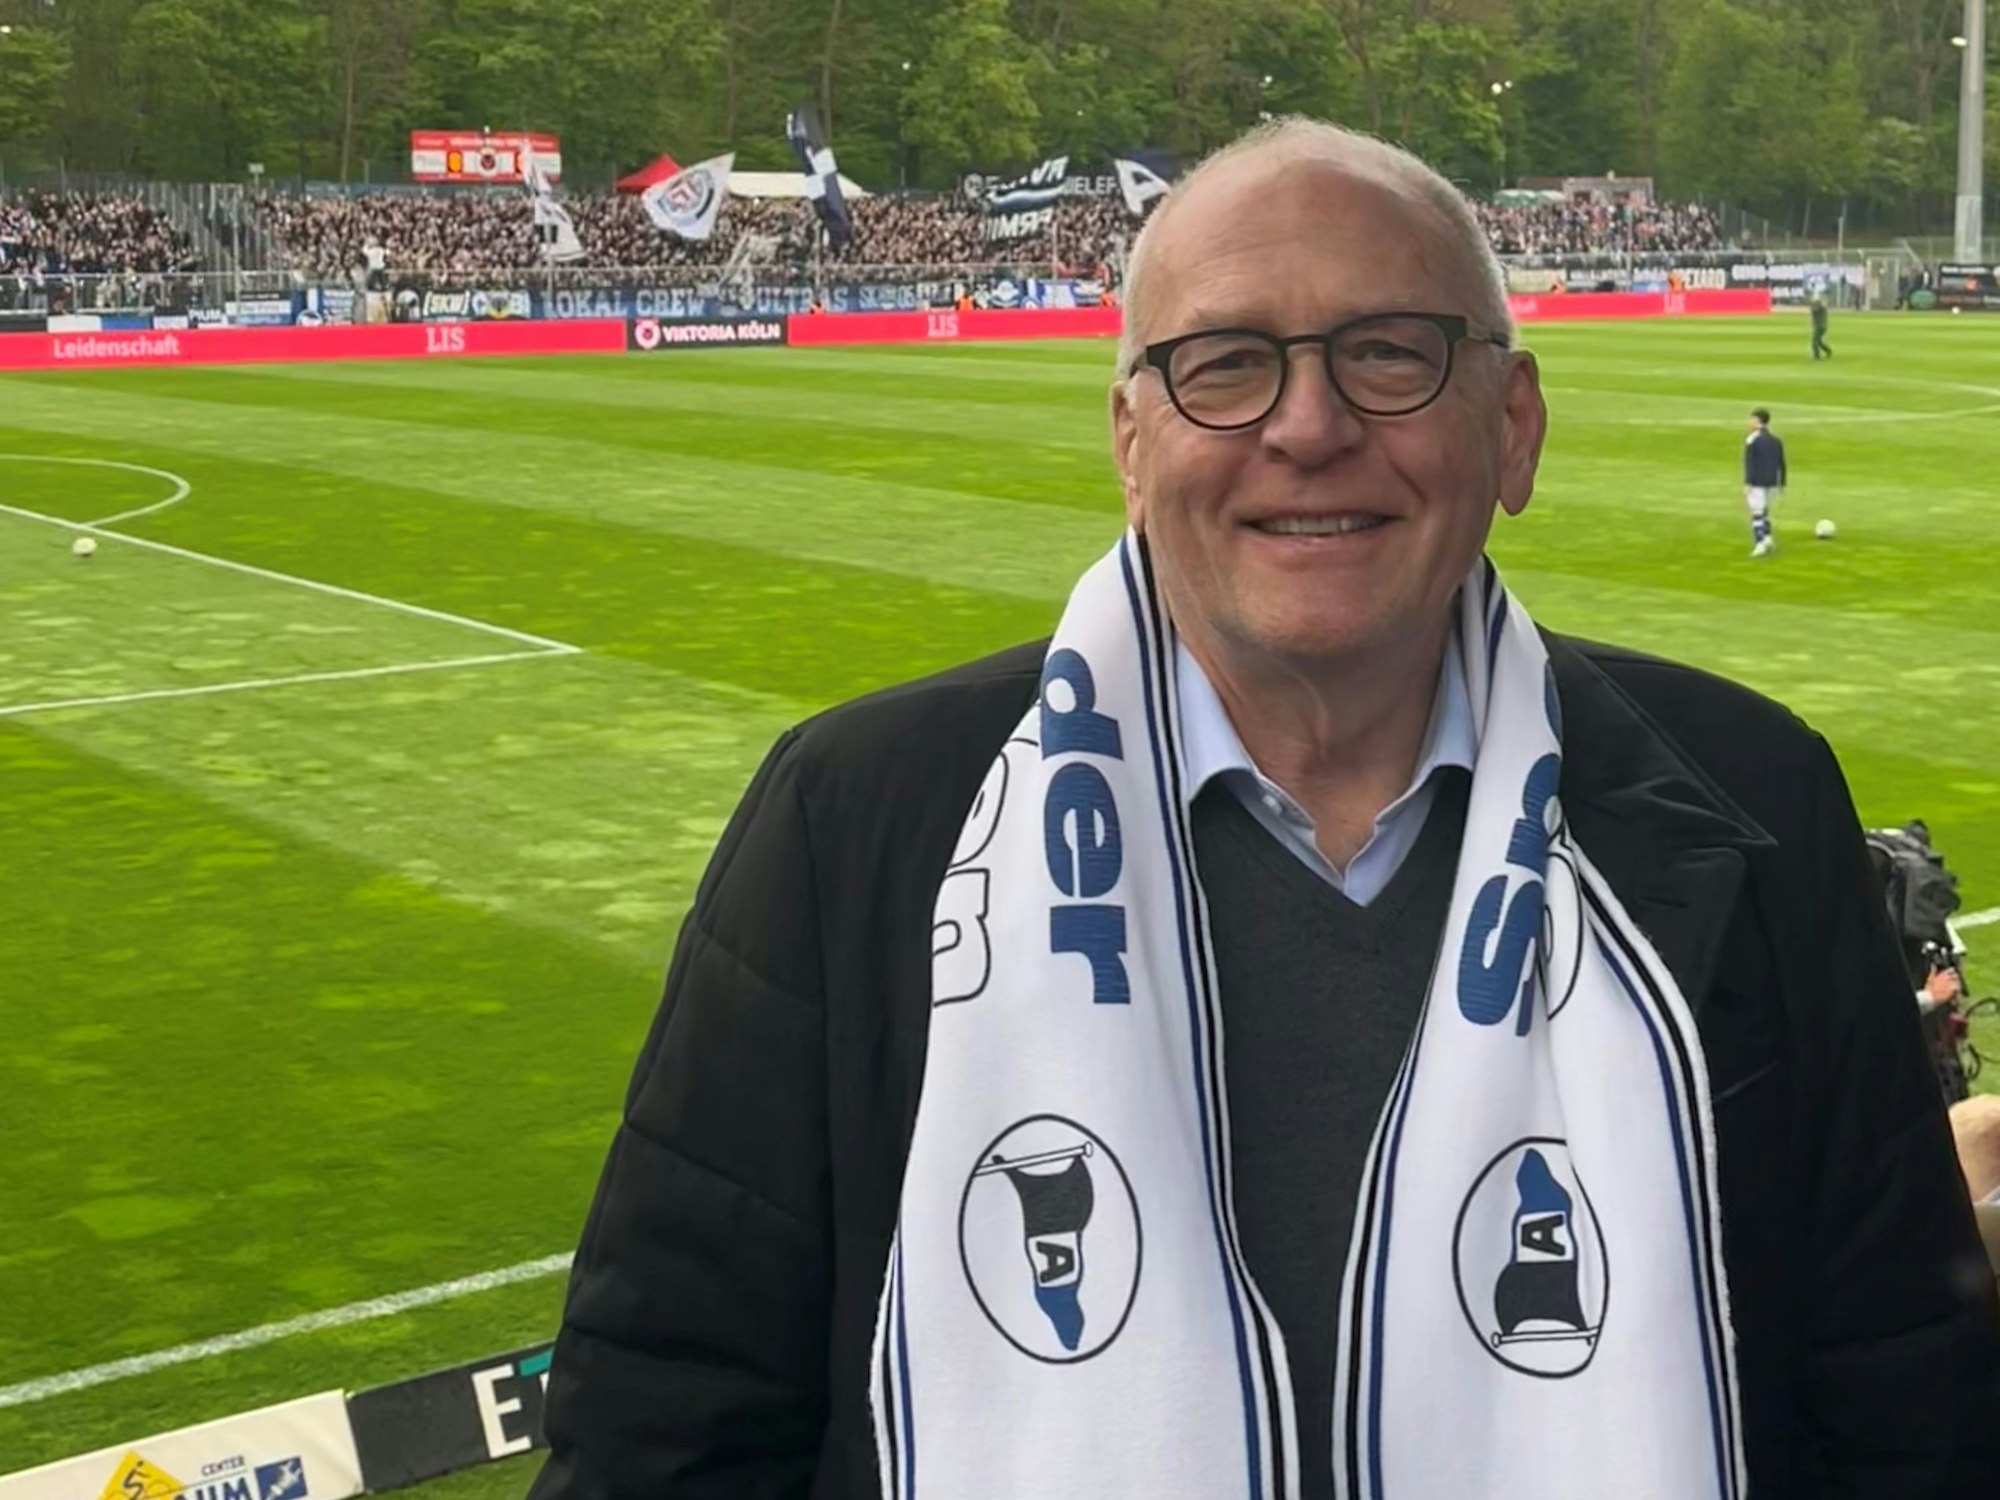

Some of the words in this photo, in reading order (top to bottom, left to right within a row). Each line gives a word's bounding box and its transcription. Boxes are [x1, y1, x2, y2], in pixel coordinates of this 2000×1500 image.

[540, 288, 629, 319] LOKAL
[635, 288, 705, 318] CREW
[662, 324, 736, 343] VIKTORIA
[737, 319, 781, 339] KÖLN
[928, 313, 960, 337] LIS
[53, 334, 181, 359] Leidenschaft
[426, 327, 466, 353] LIS
[1040, 647, 1131, 1005] der
[201, 1455, 245, 1477] CENTER
